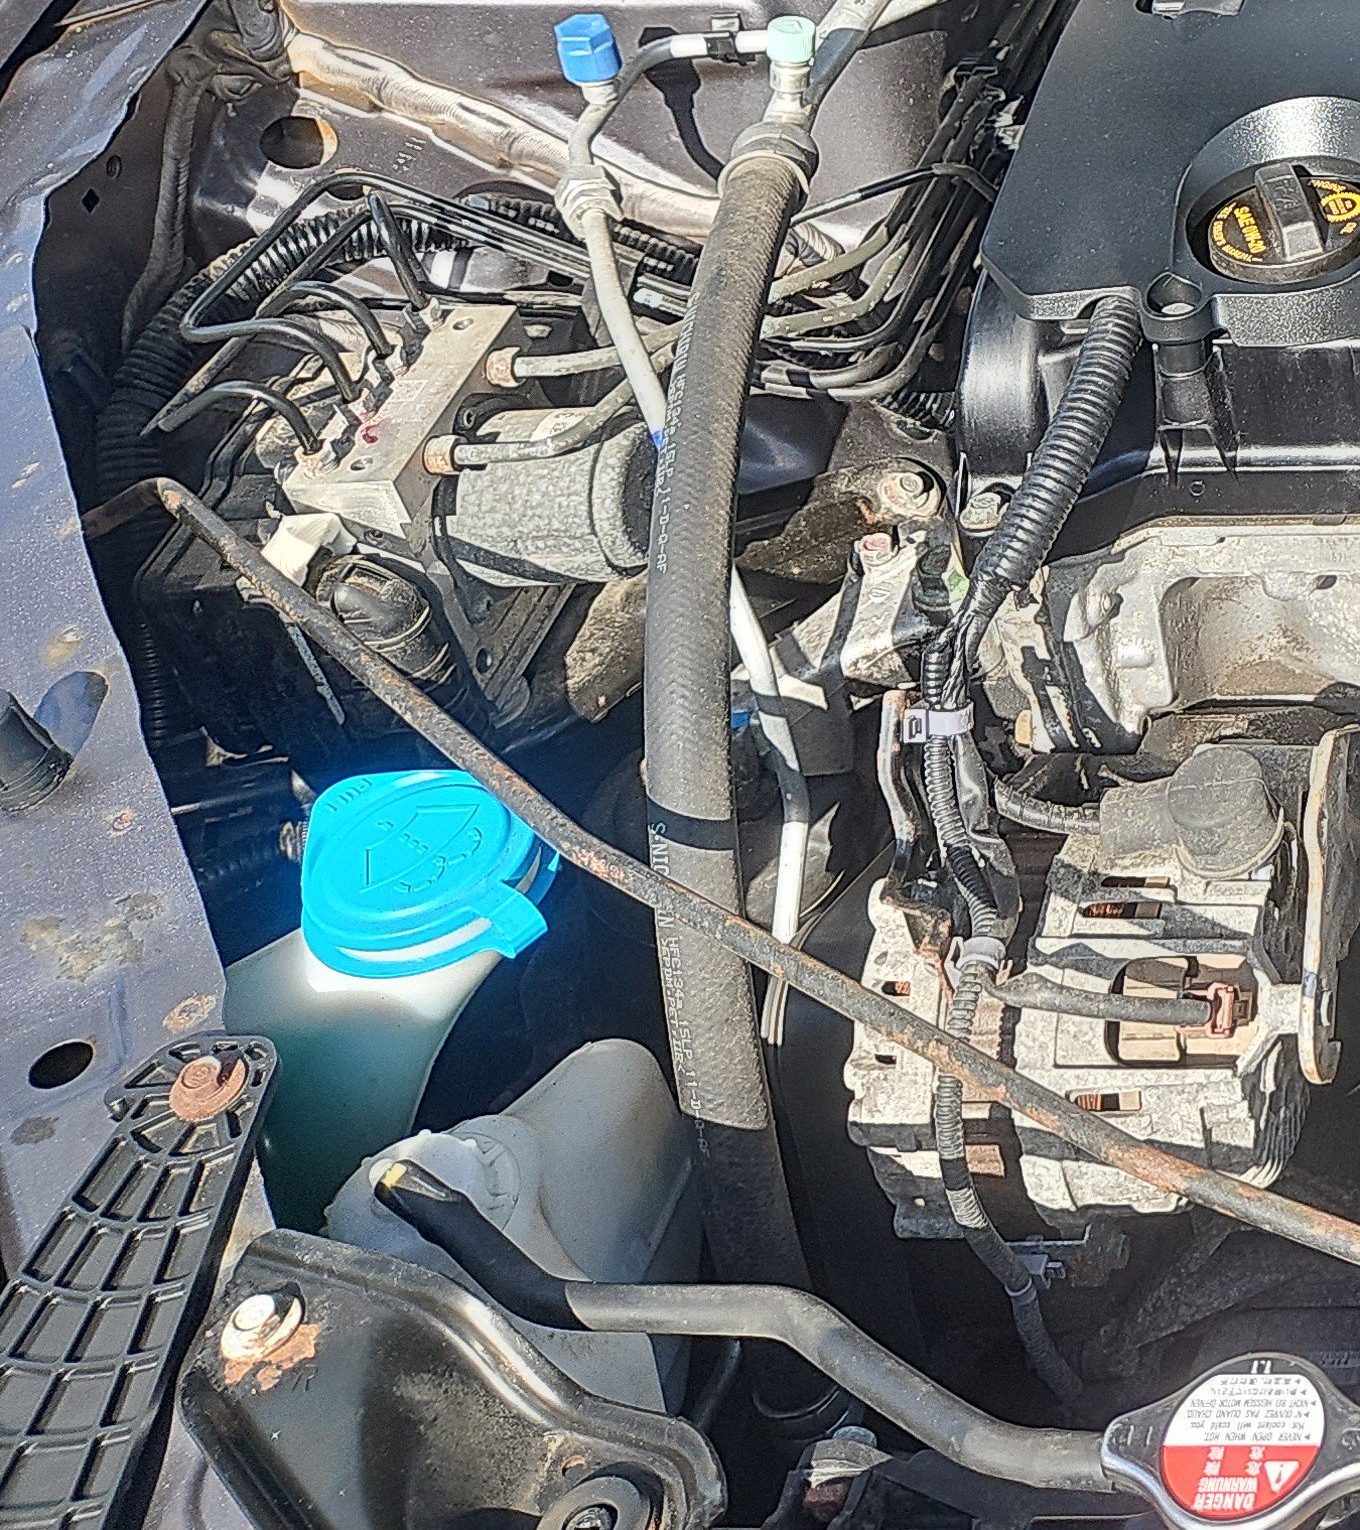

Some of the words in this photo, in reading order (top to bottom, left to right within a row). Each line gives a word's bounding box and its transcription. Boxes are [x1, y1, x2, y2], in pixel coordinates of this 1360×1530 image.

[1233, 206, 1252, 230] SAE
[1237, 1421, 1252, 1430] will
[1257, 1421, 1286, 1430] coolant
[1224, 1432, 1246, 1441] WHEN
[1252, 1432, 1273, 1441] OPEN
[1278, 1433, 1302, 1441] NEVER
[1197, 1476, 1258, 1493] WARNUNG
[1191, 1492, 1255, 1511] DANGER
